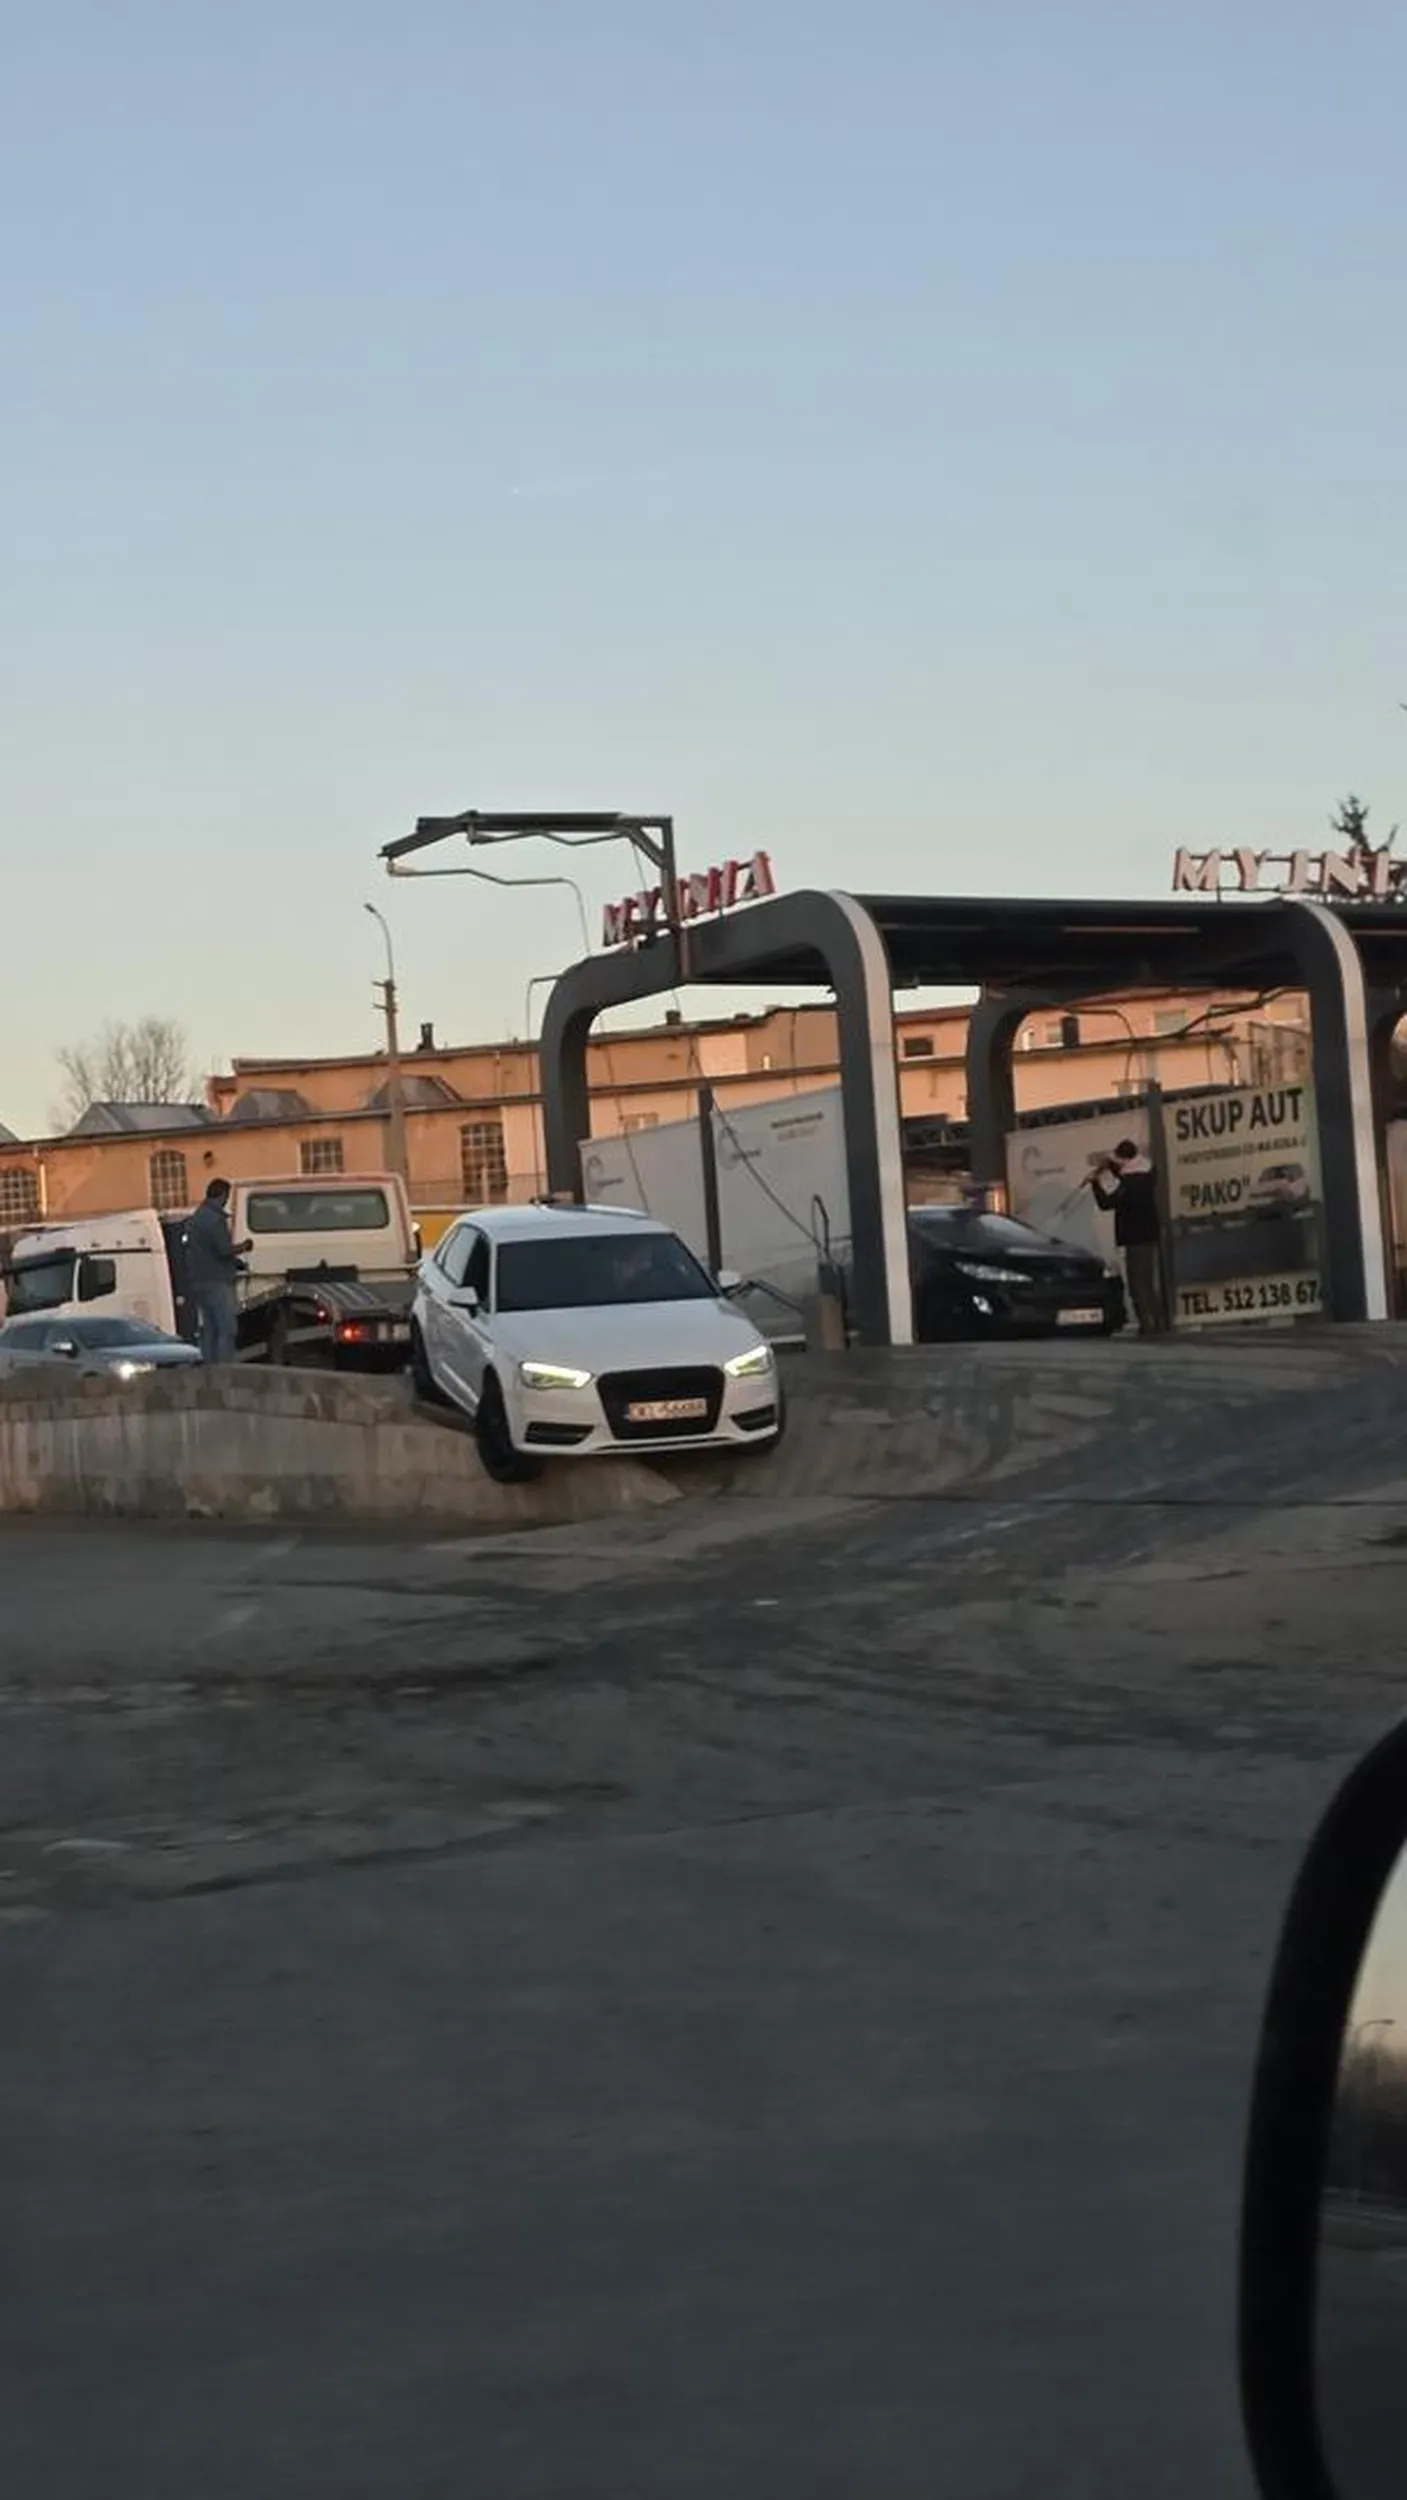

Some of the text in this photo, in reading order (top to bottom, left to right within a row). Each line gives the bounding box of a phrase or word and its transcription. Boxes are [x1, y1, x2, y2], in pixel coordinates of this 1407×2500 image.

[1171, 846, 1405, 896] MYJNI
[1175, 1088, 1304, 1141] SKUP AUT
[1180, 1291, 1220, 1316] TEL.
[1223, 1285, 1255, 1311] 512
[1258, 1281, 1292, 1308] 138
